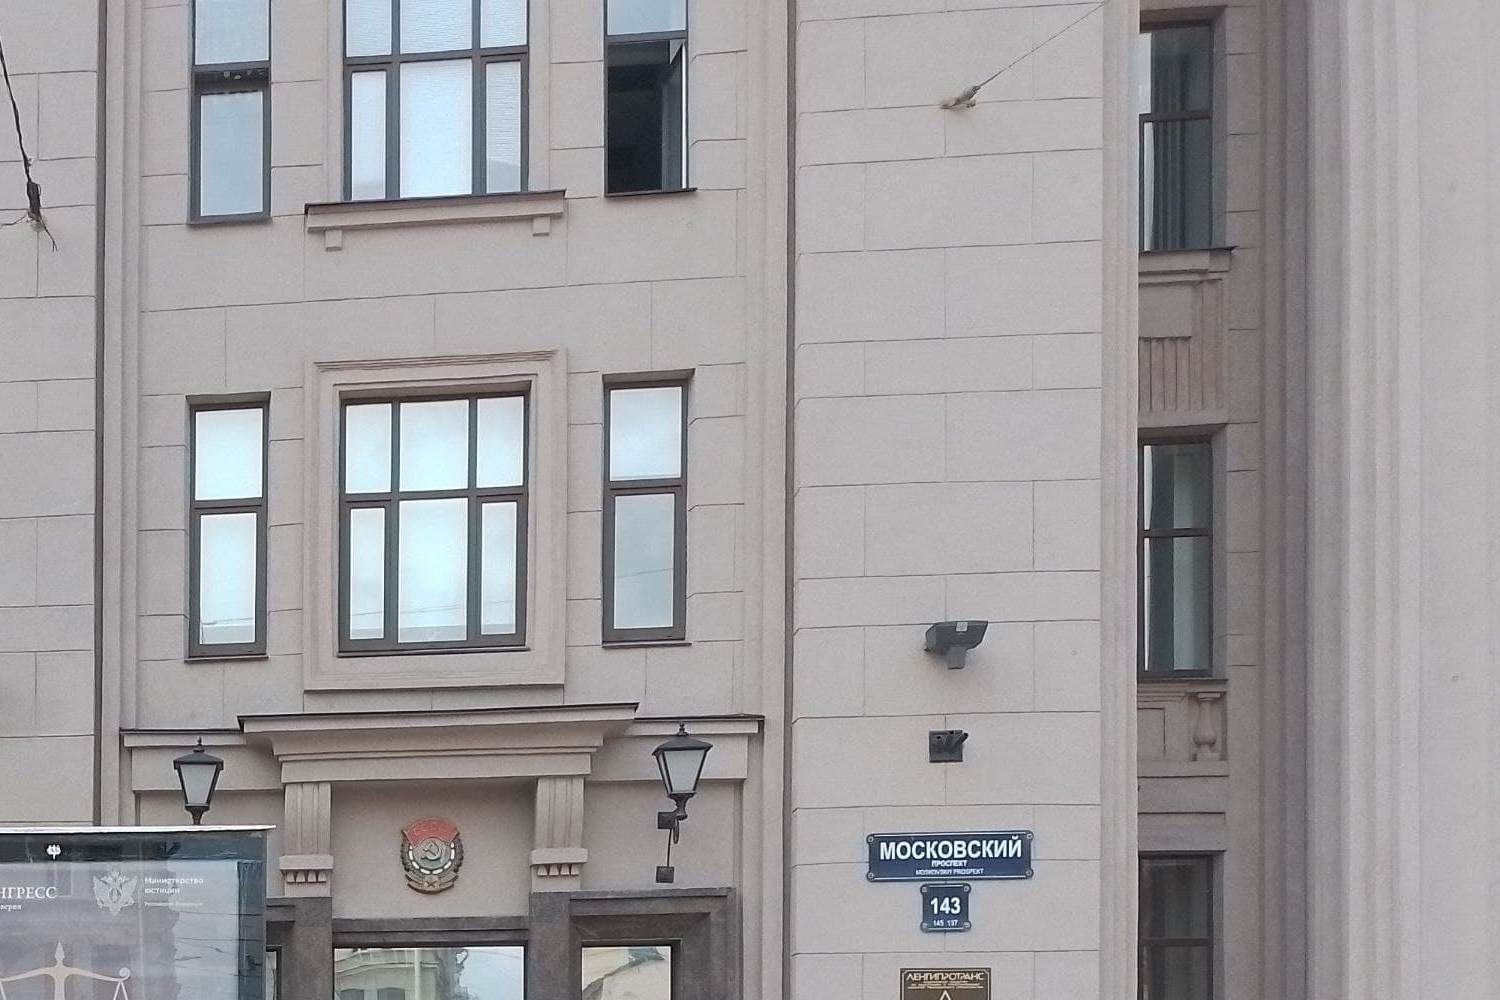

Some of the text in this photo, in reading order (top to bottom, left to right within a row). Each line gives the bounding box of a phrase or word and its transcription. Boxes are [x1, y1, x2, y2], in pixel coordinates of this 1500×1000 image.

[879, 835, 1023, 860] МОСКОВСКИЙ
[931, 859, 968, 868] ПРОСПЕКТ
[930, 896, 961, 915] 143
[905, 972, 985, 981] ЛЕНГИПРОТРАНС
